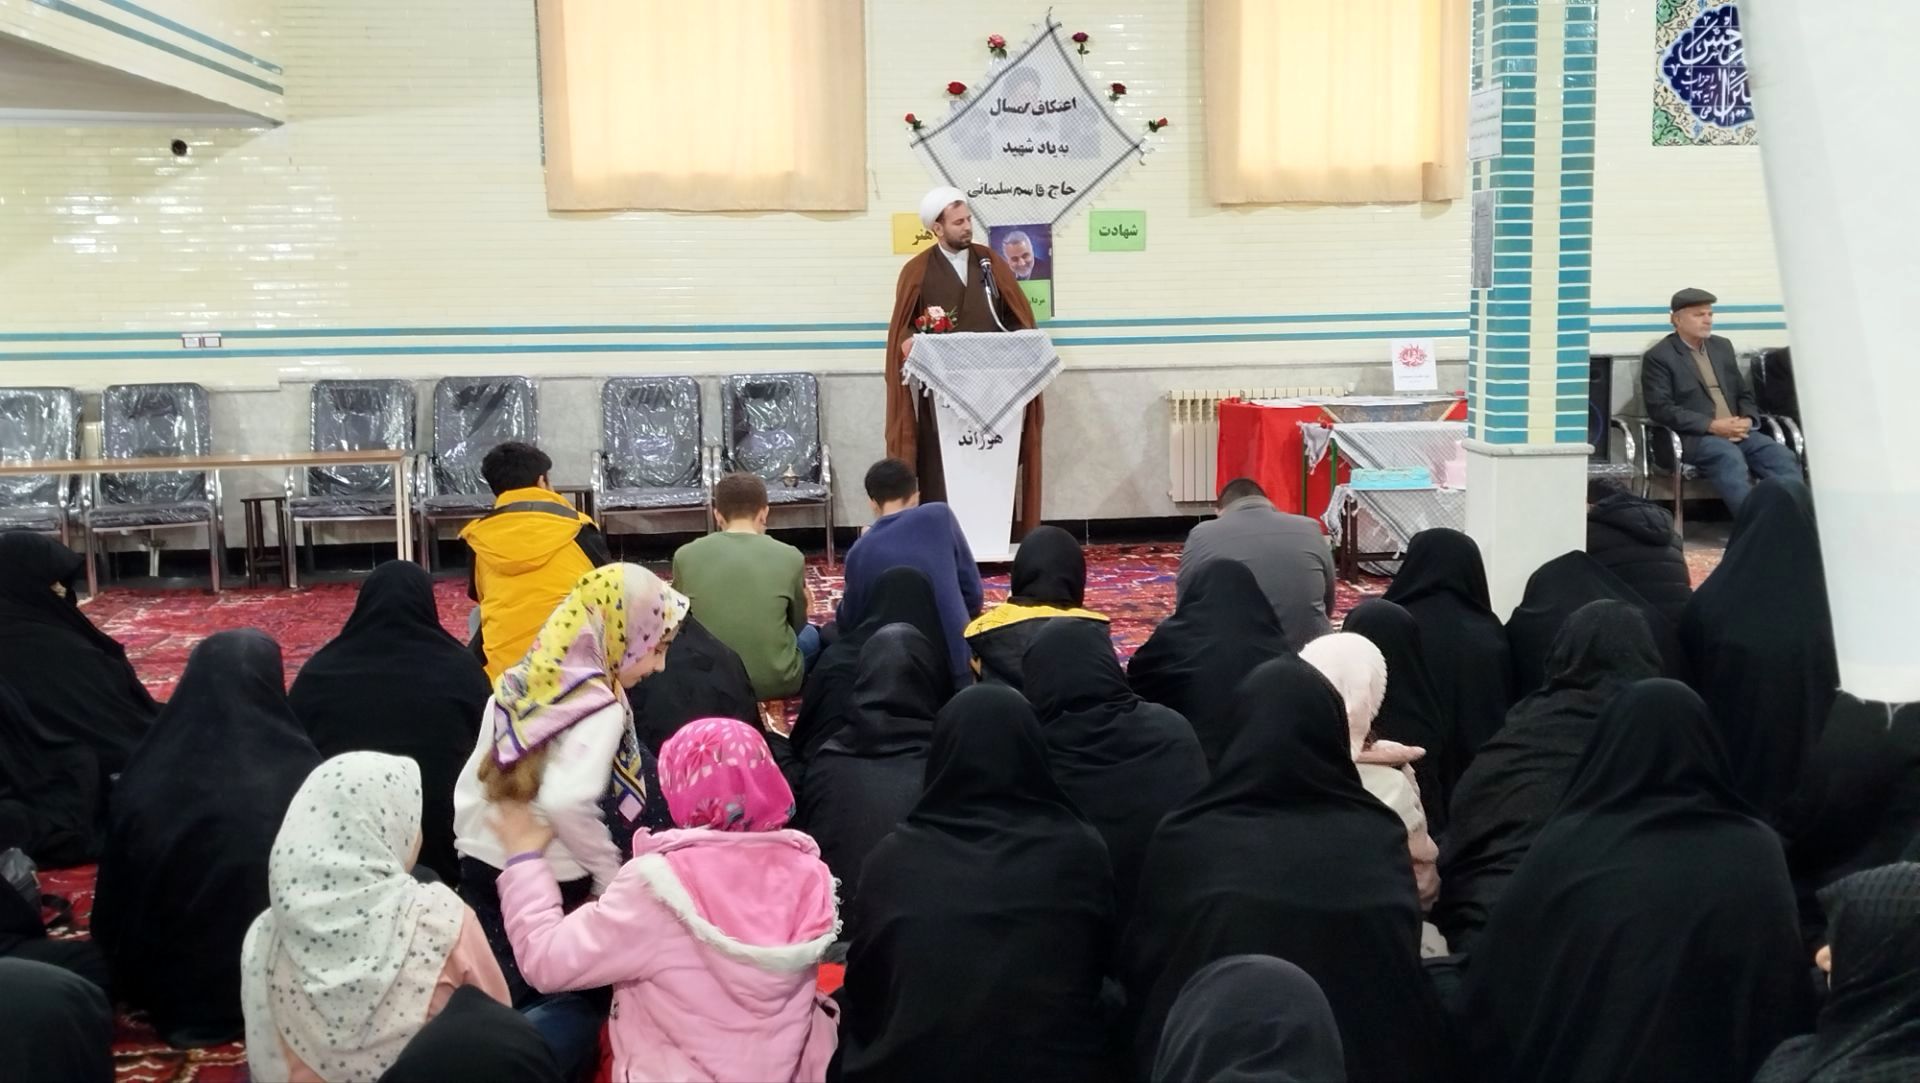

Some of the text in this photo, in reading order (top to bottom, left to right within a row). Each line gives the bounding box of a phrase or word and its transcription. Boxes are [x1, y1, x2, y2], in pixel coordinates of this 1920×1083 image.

[990, 96, 1077, 116] اعتکاف امسال
[1002, 138, 1034, 157] شهید
[967, 182, 1013, 200] سلیمانی
[1047, 181, 1077, 199] حاج
[911, 228, 933, 246] هنر
[1098, 223, 1138, 239] شهادت
[958, 430, 1004, 451] هوراند
